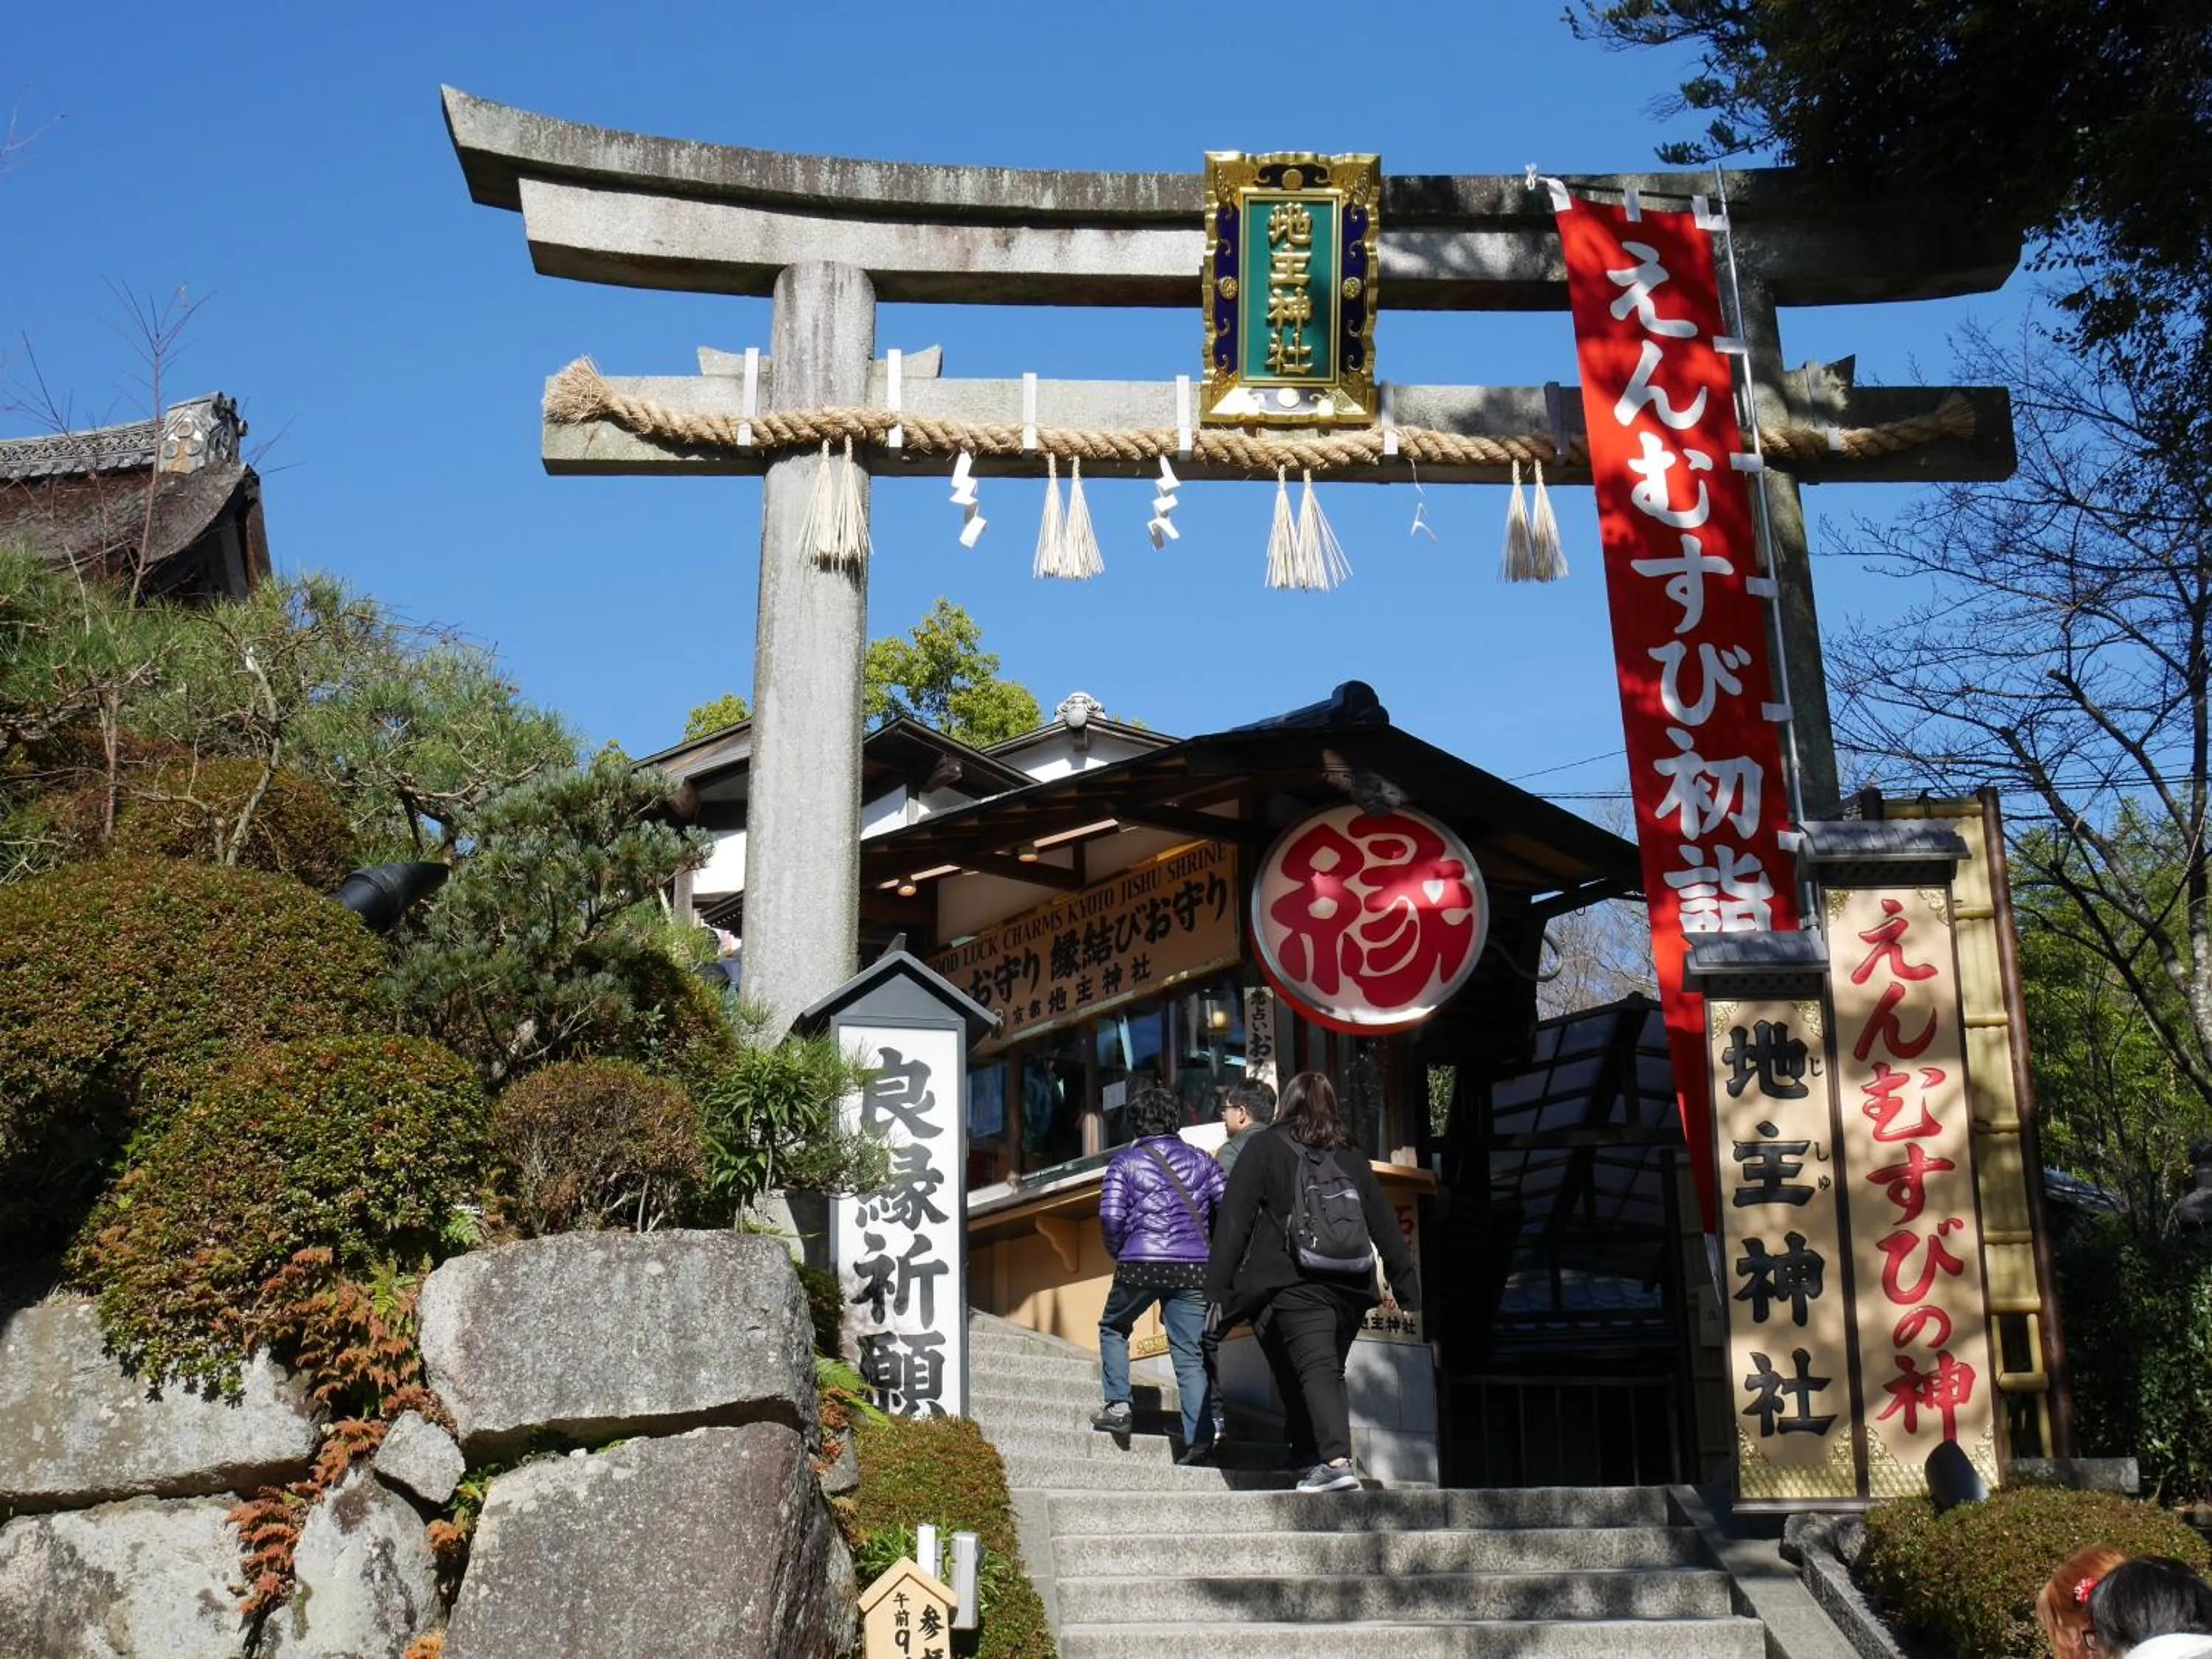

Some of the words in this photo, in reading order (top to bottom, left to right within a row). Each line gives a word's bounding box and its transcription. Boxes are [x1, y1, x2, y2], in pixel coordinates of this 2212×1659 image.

[1267, 202, 1312, 375] 地主神社
[1606, 241, 1774, 933] えんむすび初詣
[960, 947, 1040, 1008] お守り
[1051, 872, 1228, 982] 縁結びお守り
[964, 938, 998, 967] LUCK
[1003, 910, 1062, 948] CHARMS
[1068, 888, 1114, 924] KYOTO
[1121, 867, 1162, 905] JISHU
[1167, 843, 1228, 883] SHRINE
[1013, 999, 1041, 1026] 京都
[1048, 953, 1152, 1015] 地主神社
[850, 1047, 950, 1417] 良縁祈願
[1722, 1020, 1838, 1438] 地主神社
[1849, 898, 1977, 1442] えんむすびの神
